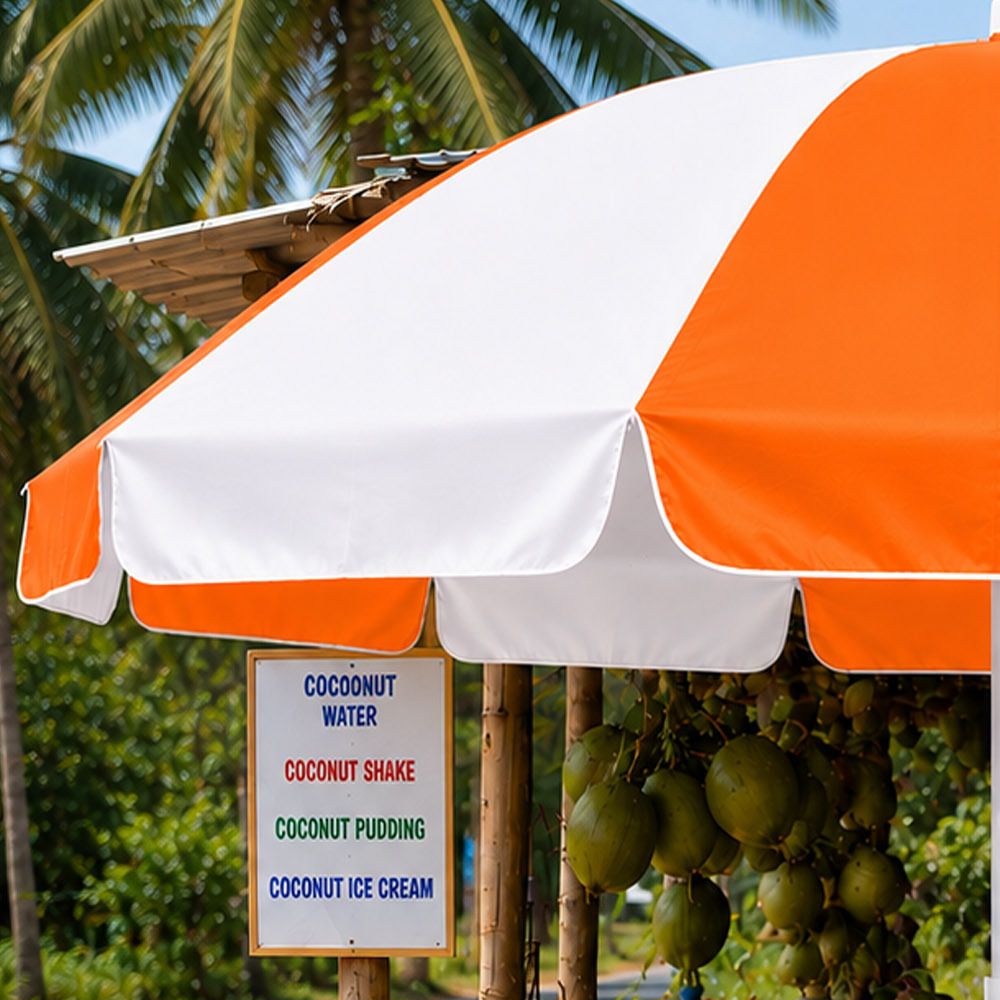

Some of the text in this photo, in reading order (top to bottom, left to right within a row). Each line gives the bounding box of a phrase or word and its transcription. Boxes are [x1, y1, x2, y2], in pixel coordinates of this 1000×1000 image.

[303, 673, 398, 697] COCOONUT
[322, 704, 378, 727] WATER
[285, 759, 416, 782] COCONUT SHAKE
[275, 816, 425, 840] COCONUT PUDDING
[269, 876, 434, 899] COCONUT ICE CREAM
